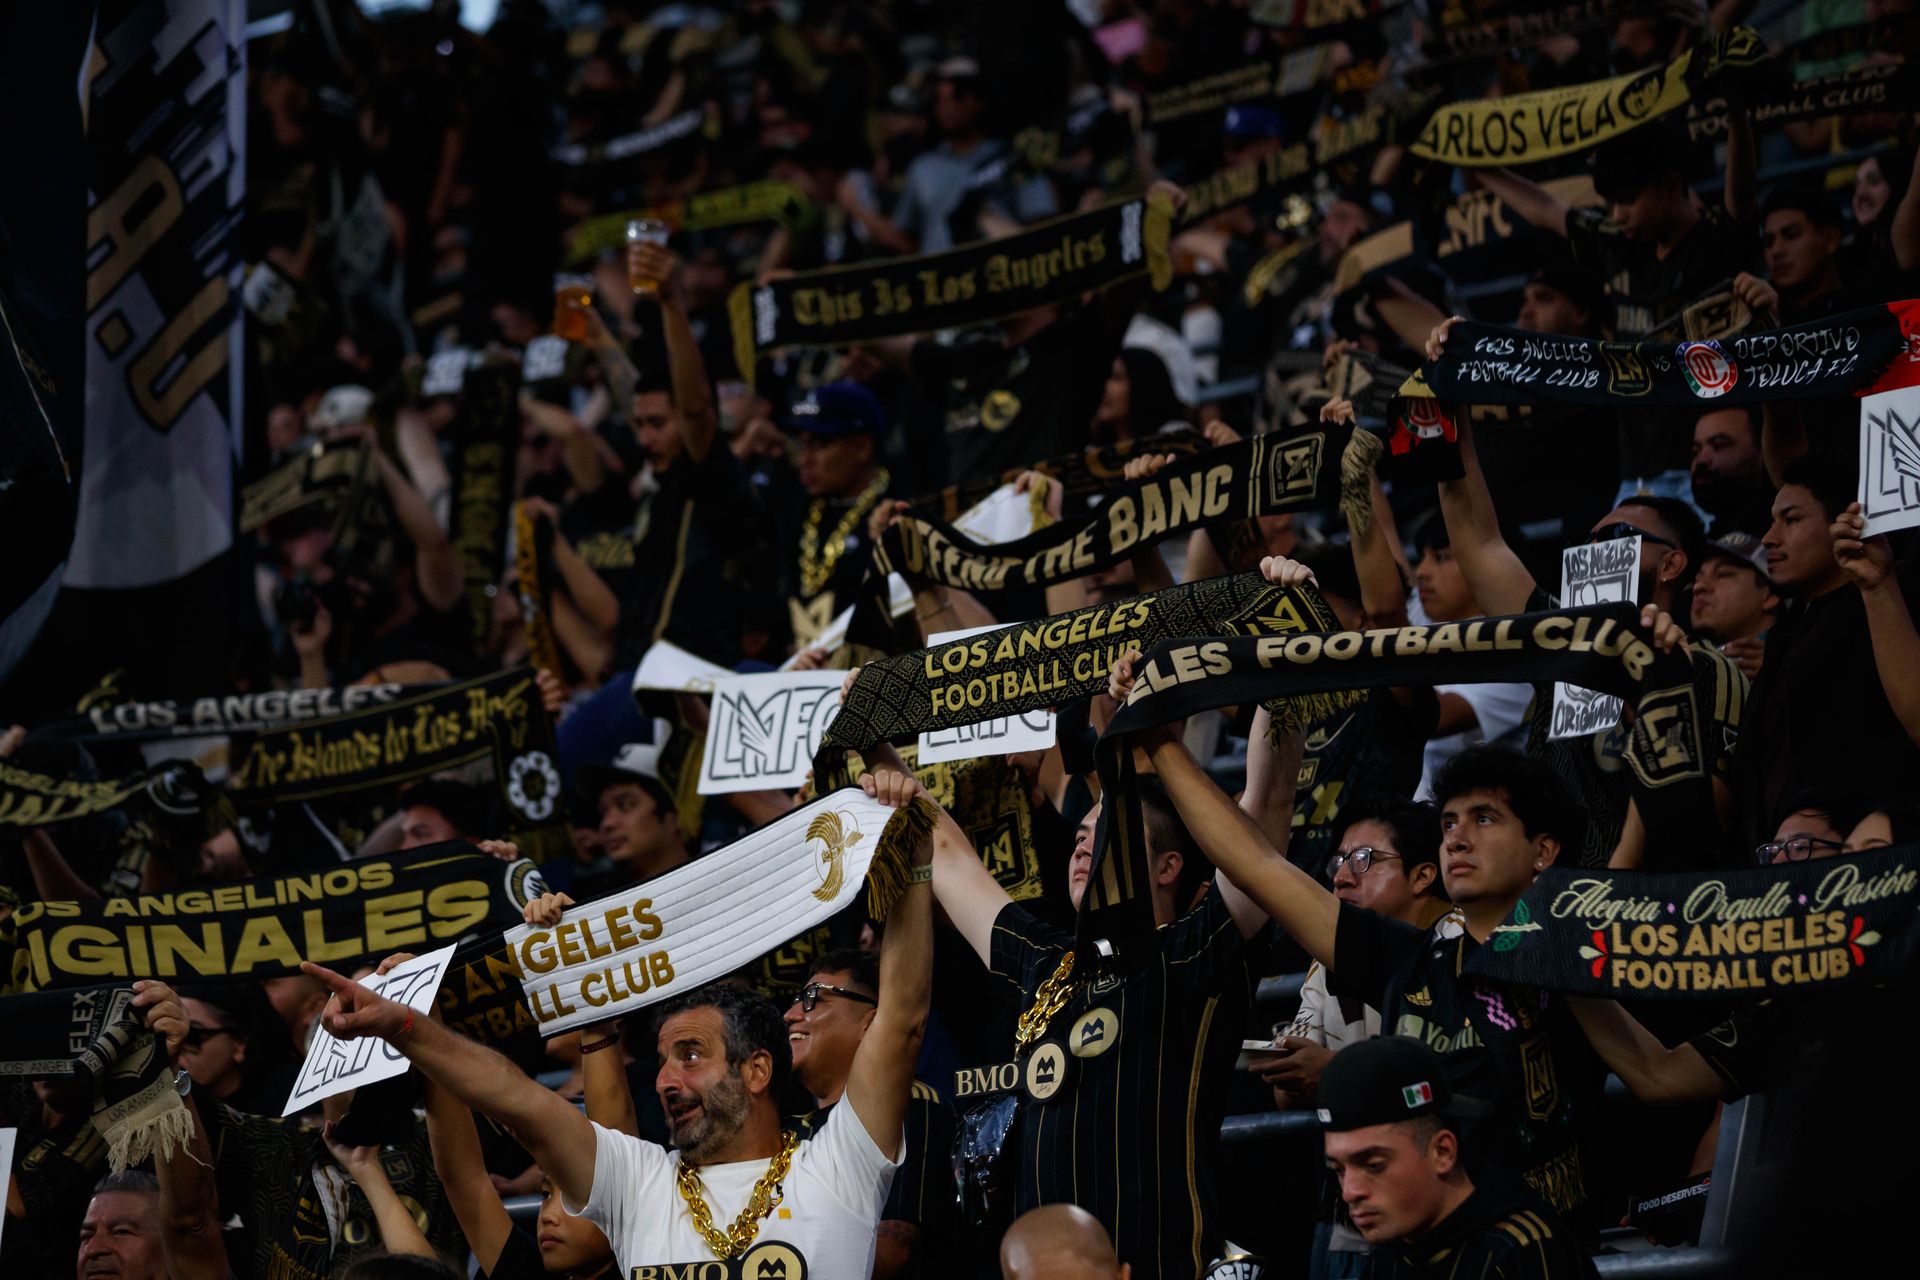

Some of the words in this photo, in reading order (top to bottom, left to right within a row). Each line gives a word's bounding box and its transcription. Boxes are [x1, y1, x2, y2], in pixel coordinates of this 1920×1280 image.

[1539, 90, 1615, 147] VELA
[1822, 82, 1887, 110] CLUB
[792, 284, 864, 329] This
[871, 278, 912, 315] Is
[918, 260, 978, 307] Los
[983, 229, 1107, 294] Angeles
[1520, 338, 1593, 365] ANGELES
[1735, 326, 1861, 360] DEPORTIVO
[1457, 359, 1542, 386] FOOTBALL
[1546, 366, 1601, 389] CLUB
[1744, 357, 1824, 389] TOLUCA
[1106, 463, 1234, 557] BANC
[924, 639, 989, 680] LOS
[993, 596, 1157, 664] ANGELES
[1256, 617, 1525, 670] FOOTBALL
[1531, 616, 1655, 682] CLUB
[88, 700, 178, 735] LOS
[191, 682, 401, 727] ANGELES
[930, 658, 1068, 726] FOOTBALL
[103, 862, 396, 918] ANGELINOS
[1682, 880, 1793, 930] Orgullo
[1809, 863, 1919, 913] Pasión
[464, 898, 664, 1005] ANGELES
[1612, 922, 1679, 956] LOS
[1682, 910, 1848, 957] ANGELES
[580, 950, 676, 1007] CLUB
[1611, 958, 1767, 992] FOOTBALL
[1770, 947, 1851, 987] CLUB
[69, 989, 99, 1054] FLEX
[955, 1062, 1019, 1097] BMO
[1638, 1197, 1661, 1214] FOOD
